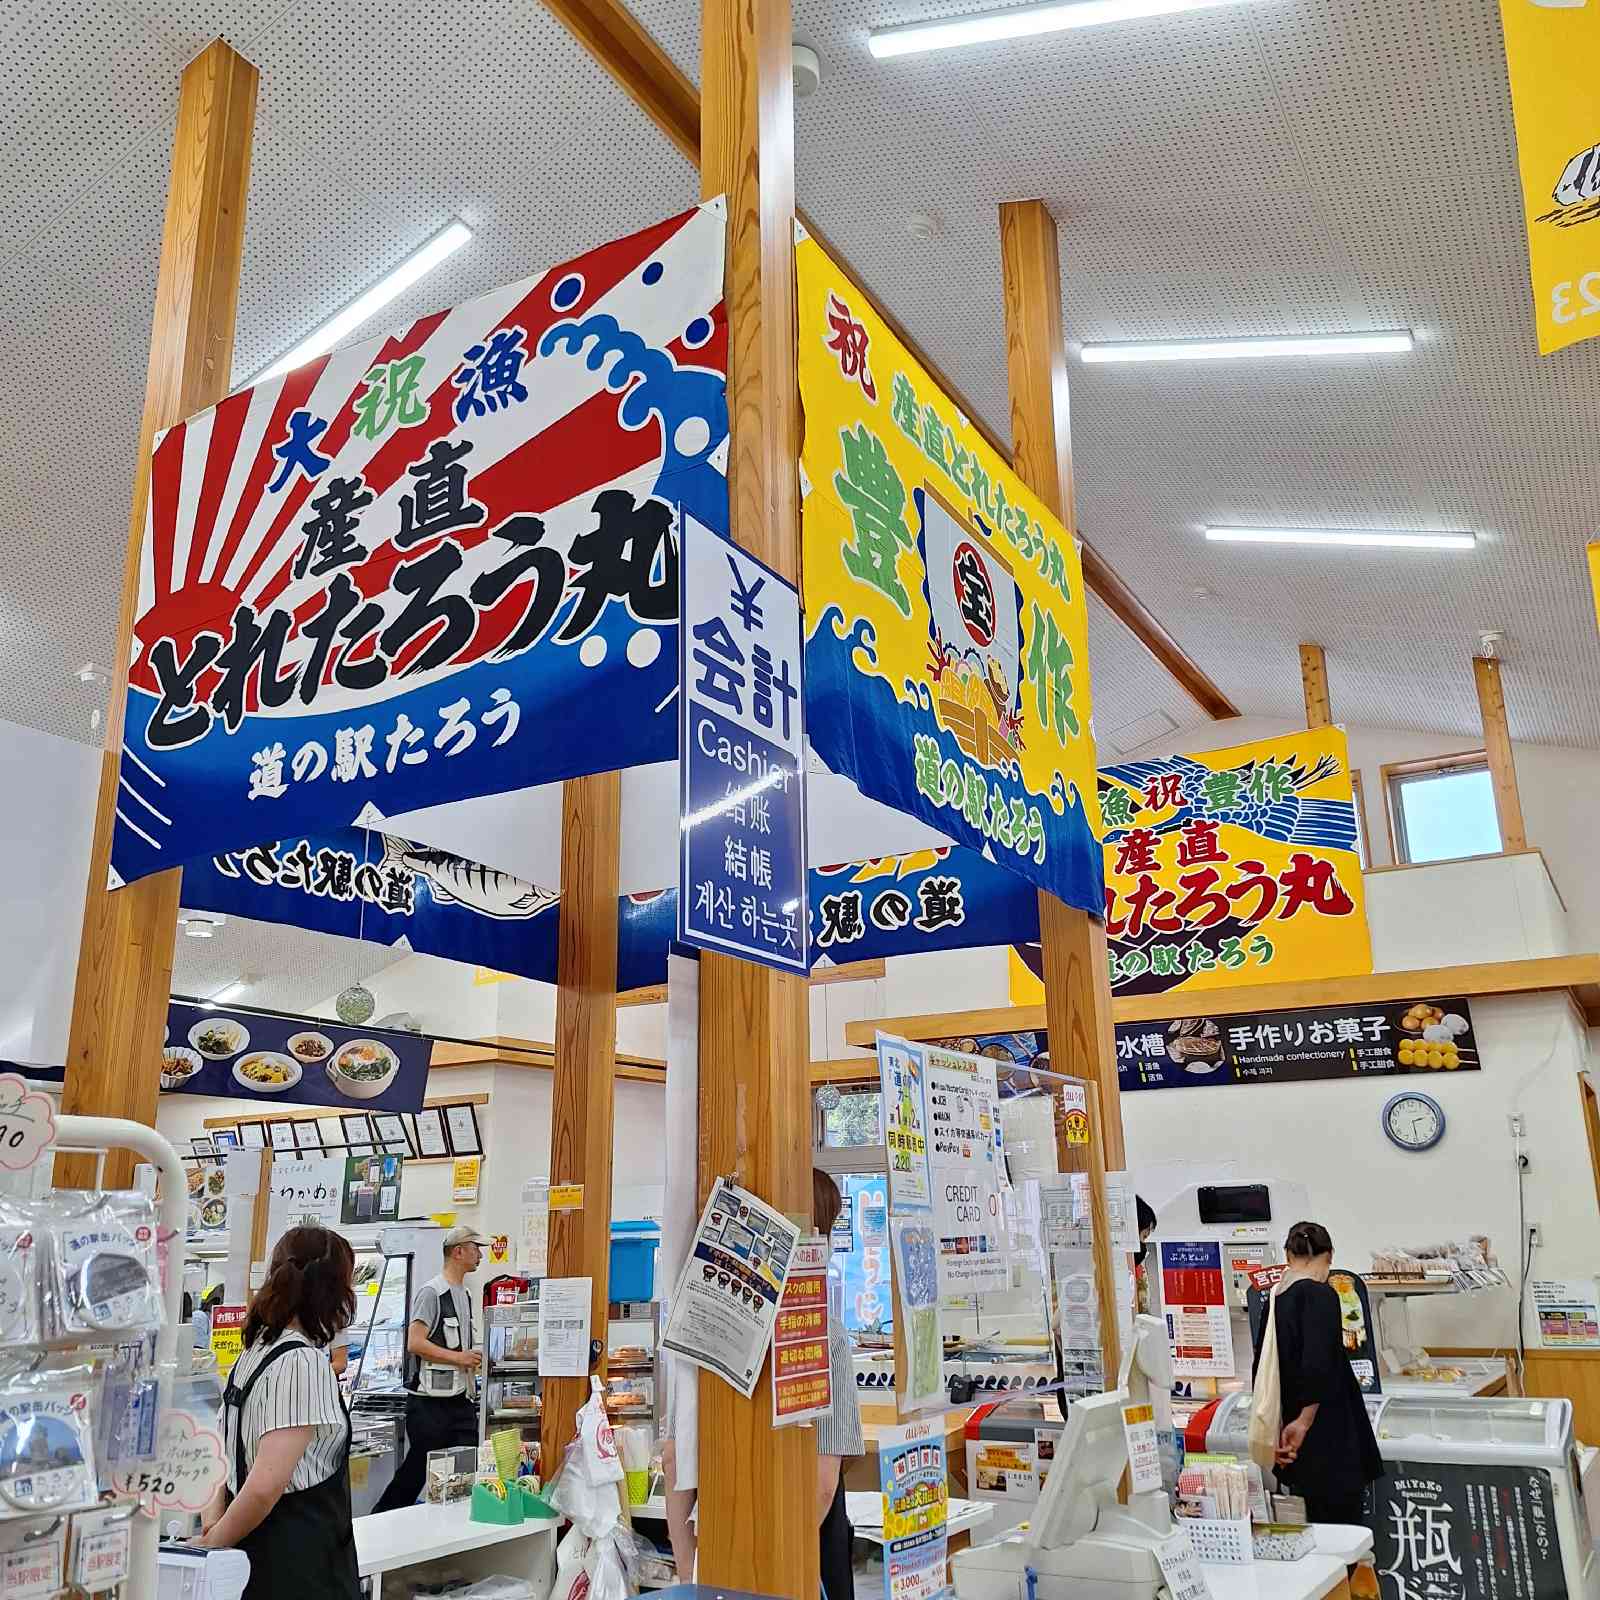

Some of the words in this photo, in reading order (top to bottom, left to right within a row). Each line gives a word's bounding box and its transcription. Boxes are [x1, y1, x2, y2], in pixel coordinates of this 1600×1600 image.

[827, 290, 877, 401] 祝
[294, 440, 486, 580] 産直
[890, 370, 1071, 602] 産直とれたろう丸
[148, 489, 684, 750] とれたろう丸
[694, 616, 798, 741] 会計
[248, 689, 521, 803] 道の駅たろう
[697, 717, 793, 793] Cashier
[914, 731, 1047, 866] 道の駅たろう
[724, 834, 772, 892] 結帳
[1114, 819, 1229, 875] 産直
[694, 880, 736, 930] 계산
[741, 894, 799, 950] 하는곳
[1229, 1016, 1391, 1051] 手作りお菓子
[1239, 1053, 1284, 1065] Handmade
[1286, 1050, 1346, 1062] confectionery
[945, 1185, 978, 1203] CREDIT
[956, 1206, 981, 1222] CARD
